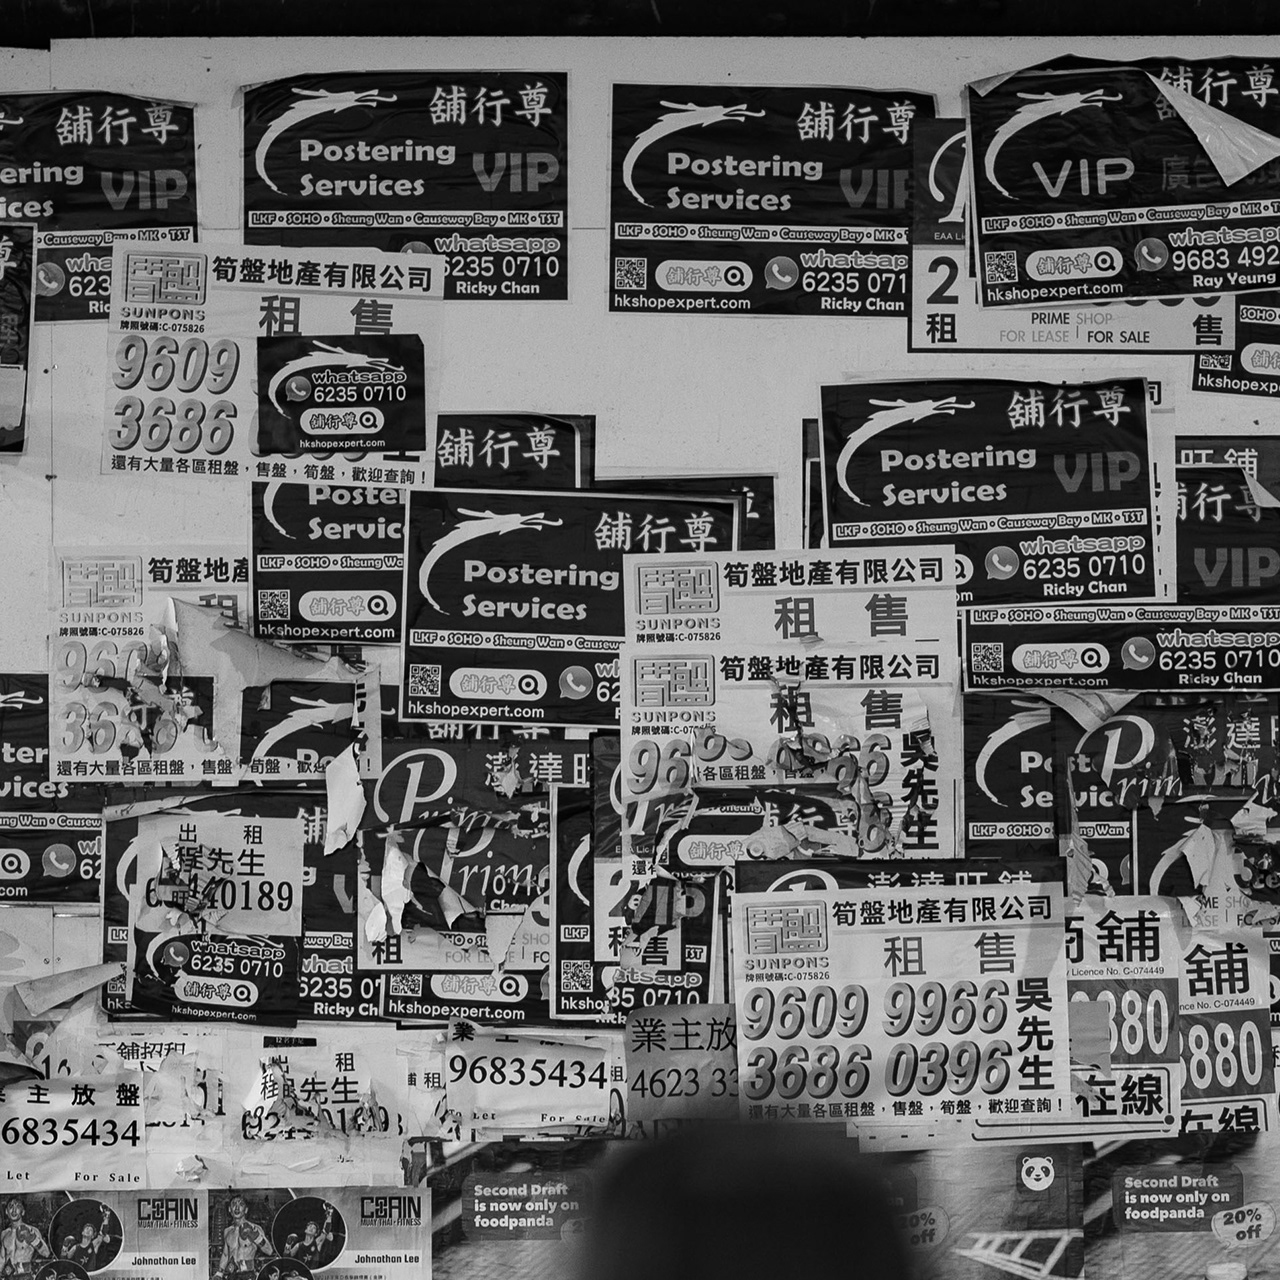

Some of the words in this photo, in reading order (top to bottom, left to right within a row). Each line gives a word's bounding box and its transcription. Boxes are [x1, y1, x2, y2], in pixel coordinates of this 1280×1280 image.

[430, 83, 553, 127] 舖行尊
[300, 139, 456, 166] Postering
[472, 153, 559, 192] VIP
[1032, 158, 1135, 197] VIP
[300, 174, 425, 197] Services
[434, 234, 560, 254] whatsapp
[212, 257, 431, 292] 筍盤地產有限公司
[503, 257, 559, 277] 0710
[457, 281, 497, 297] Ricky
[503, 281, 540, 295] Chan
[987, 281, 1124, 301] hkshopexpert.com
[121, 307, 205, 321] SUNPONS
[1032, 312, 1070, 326] PRIME
[1076, 312, 1112, 326] SHOP
[927, 314, 958, 343] 租
[1193, 315, 1224, 345] 售
[1000, 329, 1027, 342] FOR
[1032, 329, 1069, 342] LEASE
[1087, 330, 1114, 343] FOR
[1119, 330, 1150, 343] SALE
[113, 335, 241, 395] 9609
[313, 369, 405, 385] whatsapp
[314, 385, 359, 403] 6235
[363, 385, 407, 402] 0710
[1008, 386, 1131, 429] 舖行尊
[110, 400, 237, 455] 3686
[299, 437, 386, 450] hkshopexpert.com
[881, 446, 1037, 473] Postering
[1053, 454, 1140, 494] VIP
[883, 483, 1008, 507] Services
[1020, 536, 1145, 558] whatsapp
[723, 556, 944, 588] 筍盤地產有限公司
[1024, 558, 1081, 581] 6235
[1089, 554, 1146, 577] 0710
[636, 617, 720, 630] SUNPONS
[775, 596, 816, 640] 租
[865, 593, 909, 638] 售
[408, 702, 545, 721] hkshopexpert.com
[179, 823, 198, 844] 出
[244, 824, 263, 845] 租
[832, 894, 1052, 927] 筍盤地產有限公司
[191, 938, 285, 961] whatsapp
[884, 936, 926, 978] 租
[975, 932, 1017, 975] 售
[191, 954, 238, 974] 6235
[243, 957, 284, 978] 0710
[744, 956, 830, 971] SUNPONS
[1075, 968, 1106, 977] Licence
[1108, 967, 1123, 976] No.
[1125, 966, 1165, 976] C-074449
[171, 1004, 257, 1022] hkshopexpert.com
[742, 983, 869, 1040] 9609
[883, 979, 1010, 1037] 9966
[1016, 979, 1054, 1093] 吳先生
[448, 1054, 608, 1089] 96835434
[746, 1043, 873, 1100] 3686
[885, 1039, 1012, 1098] 0396
[632, 1067, 701, 1099] 4623
[1074, 1074, 1164, 1118] 在線
[7, 1171, 29, 1181] Let
[74, 1172, 97, 1182] For
[110, 1173, 141, 1183] Sale
[1124, 1177, 1176, 1189] Second
[1180, 1175, 1219, 1188] Draft
[1124, 1192, 1136, 1204] is
[1140, 1193, 1173, 1203] now
[1177, 1191, 1207, 1205] only
[1211, 1192, 1230, 1202] on
[1124, 1206, 1205, 1221] foodpanda
[1222, 1209, 1263, 1225] 20%
[1236, 1225, 1262, 1242] off
[404, 1254, 419, 1263] Lee
